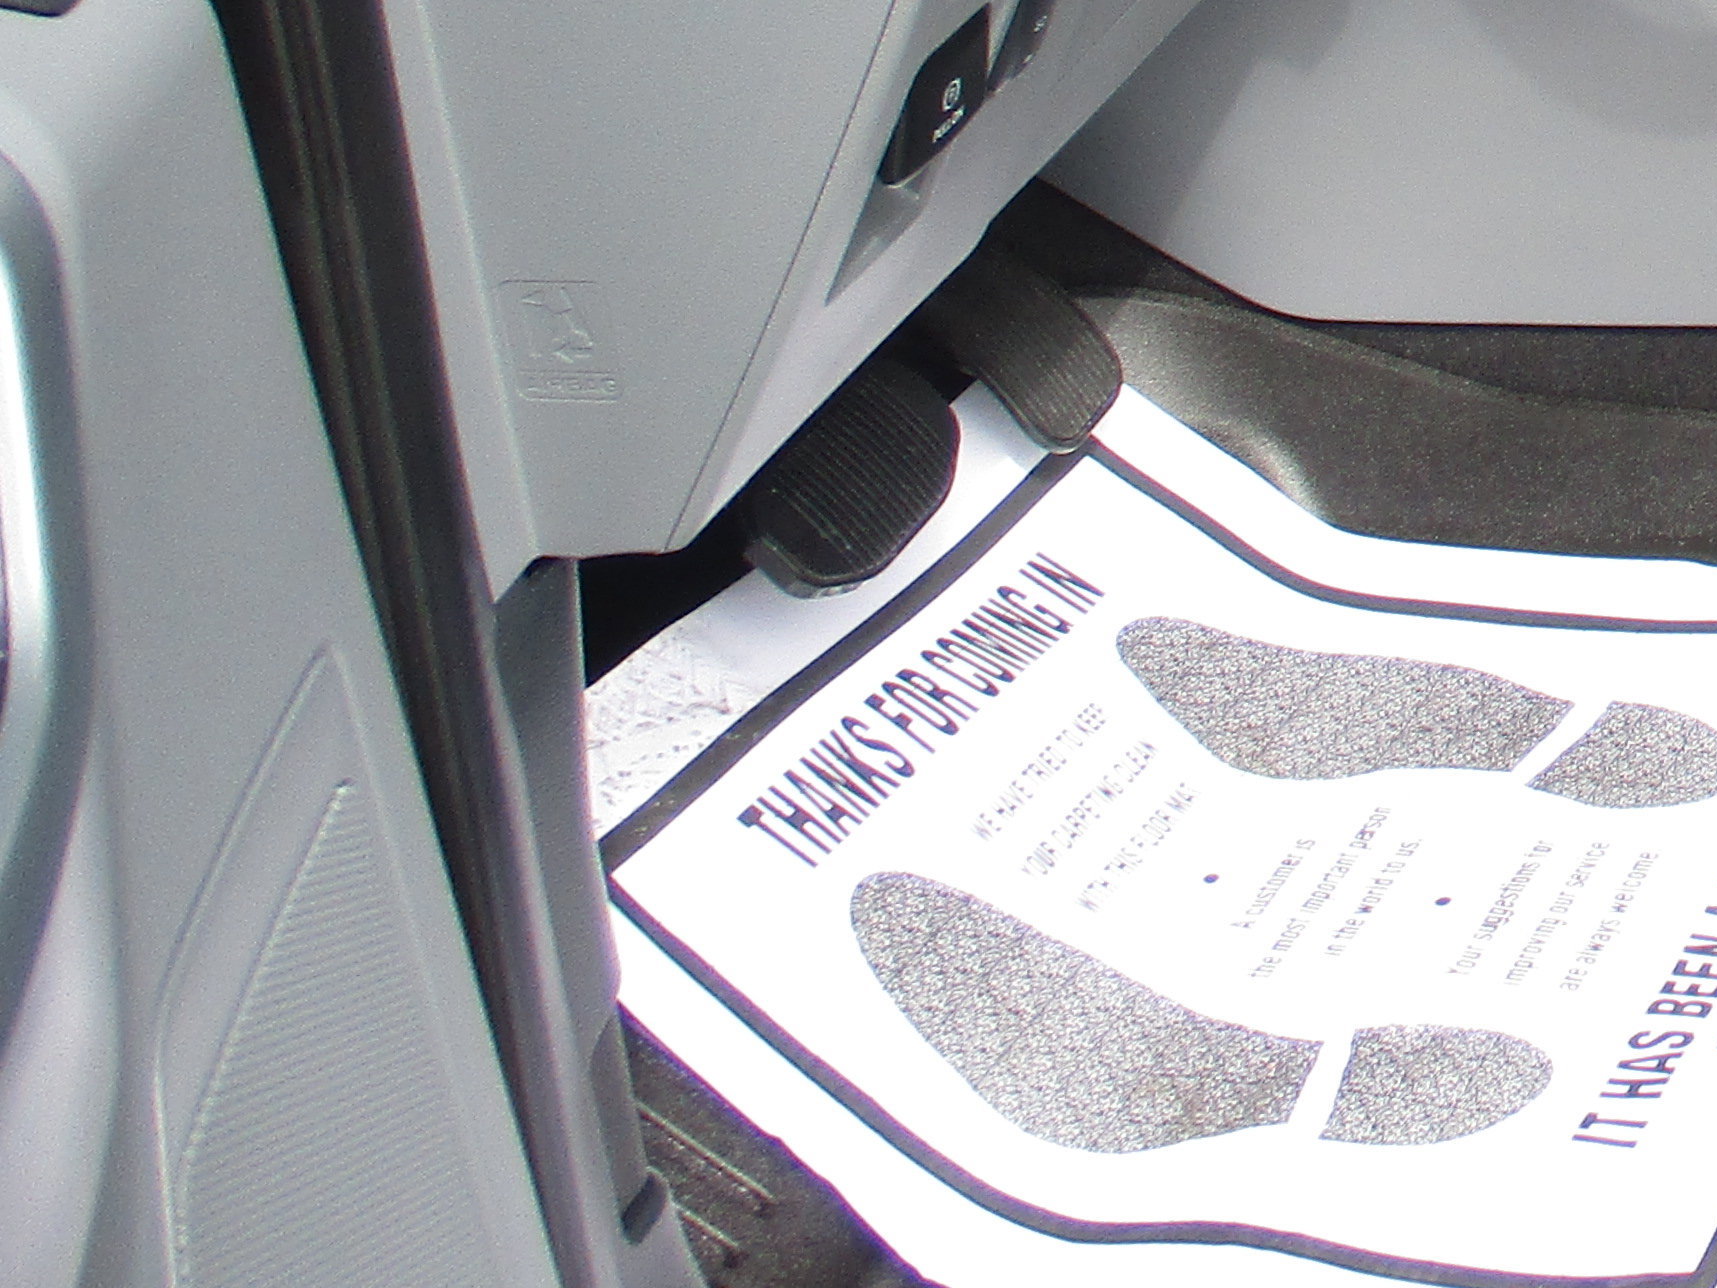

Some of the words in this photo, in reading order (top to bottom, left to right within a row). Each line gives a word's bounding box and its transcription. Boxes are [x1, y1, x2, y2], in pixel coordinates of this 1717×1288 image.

[1018, 552, 1106, 614] IN
[920, 585, 1073, 697] COMING
[864, 668, 980, 754] FOR
[737, 715, 915, 867] THANKS
[1245, 853, 1304, 916] customer
[1295, 838, 1316, 851] is
[1247, 956, 1282, 979] the
[1272, 917, 1311, 952] most
[1299, 852, 1359, 914] important
[1349, 806, 1392, 850] person
[1354, 876, 1394, 914] world
[1381, 861, 1406, 873] to
[1332, 917, 1365, 940] the
[1446, 945, 1485, 976] Your
[1473, 860, 1541, 942] suggestions
[1523, 839, 1554, 858] for
[1504, 916, 1568, 986] improving
[1549, 890, 1576, 914] our
[1565, 840, 1611, 888] service
[1324, 943, 1346, 956] in
[1559, 966, 1588, 992] are
[1576, 918, 1621, 965] always
[1599, 1030, 1695, 1098] HAS
[1571, 1112, 1649, 1149] IT
